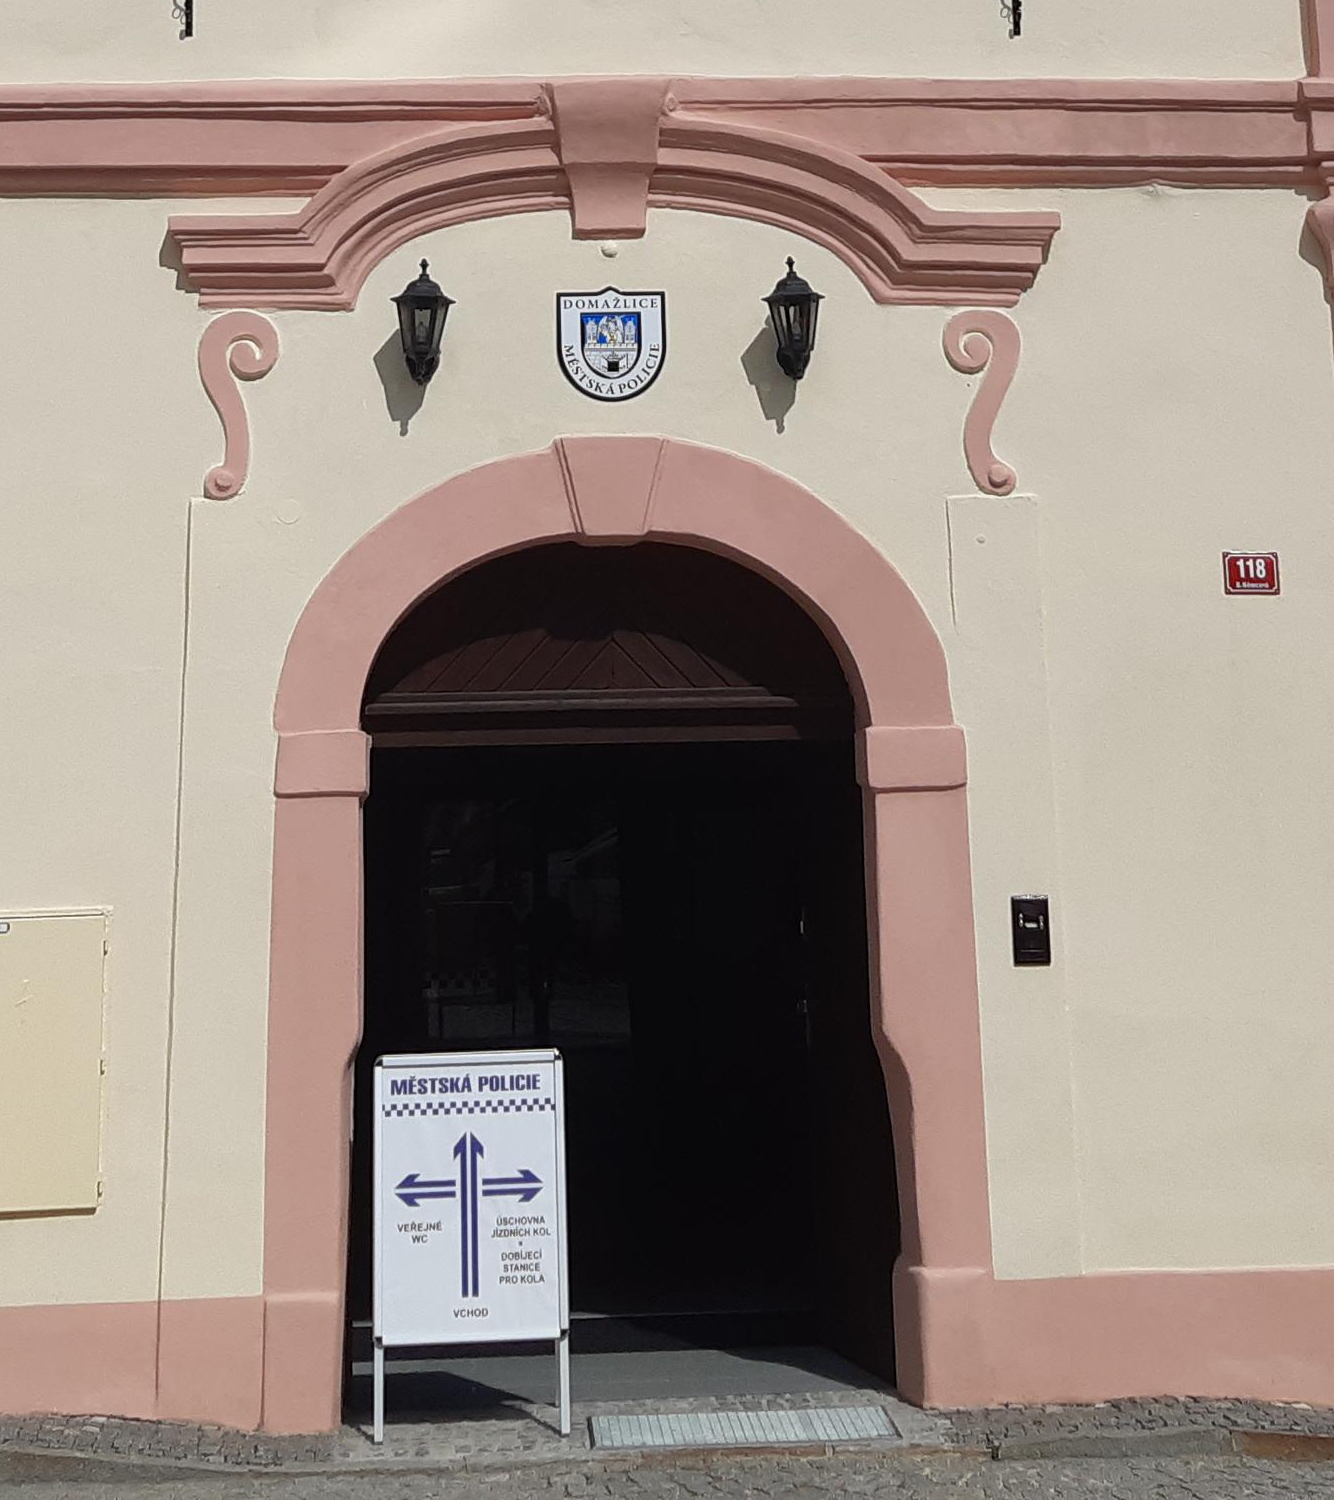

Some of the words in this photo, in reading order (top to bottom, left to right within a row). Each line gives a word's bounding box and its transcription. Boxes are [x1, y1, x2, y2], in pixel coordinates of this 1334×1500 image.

[563, 297, 659, 310] DOMAŽLICE
[618, 343, 660, 394] POLICIE
[1236, 558, 1266, 579] 118
[390, 1073, 472, 1096] MĚSTSKÁ
[478, 1073, 541, 1093] POLICIE
[397, 1220, 443, 1233] VEŘEJNÉ
[496, 1215, 546, 1226] ÚSCHOVNA
[491, 1226, 531, 1238] JÍZDNÍCH
[533, 1227, 551, 1236] KOL
[411, 1234, 428, 1244] WC
[501, 1248, 543, 1262] DOBÍJECÍ
[503, 1262, 541, 1273] STANICE
[499, 1275, 518, 1285] PRO
[520, 1274, 545, 1285] KOLA
[453, 1307, 489, 1319] VCHOD
